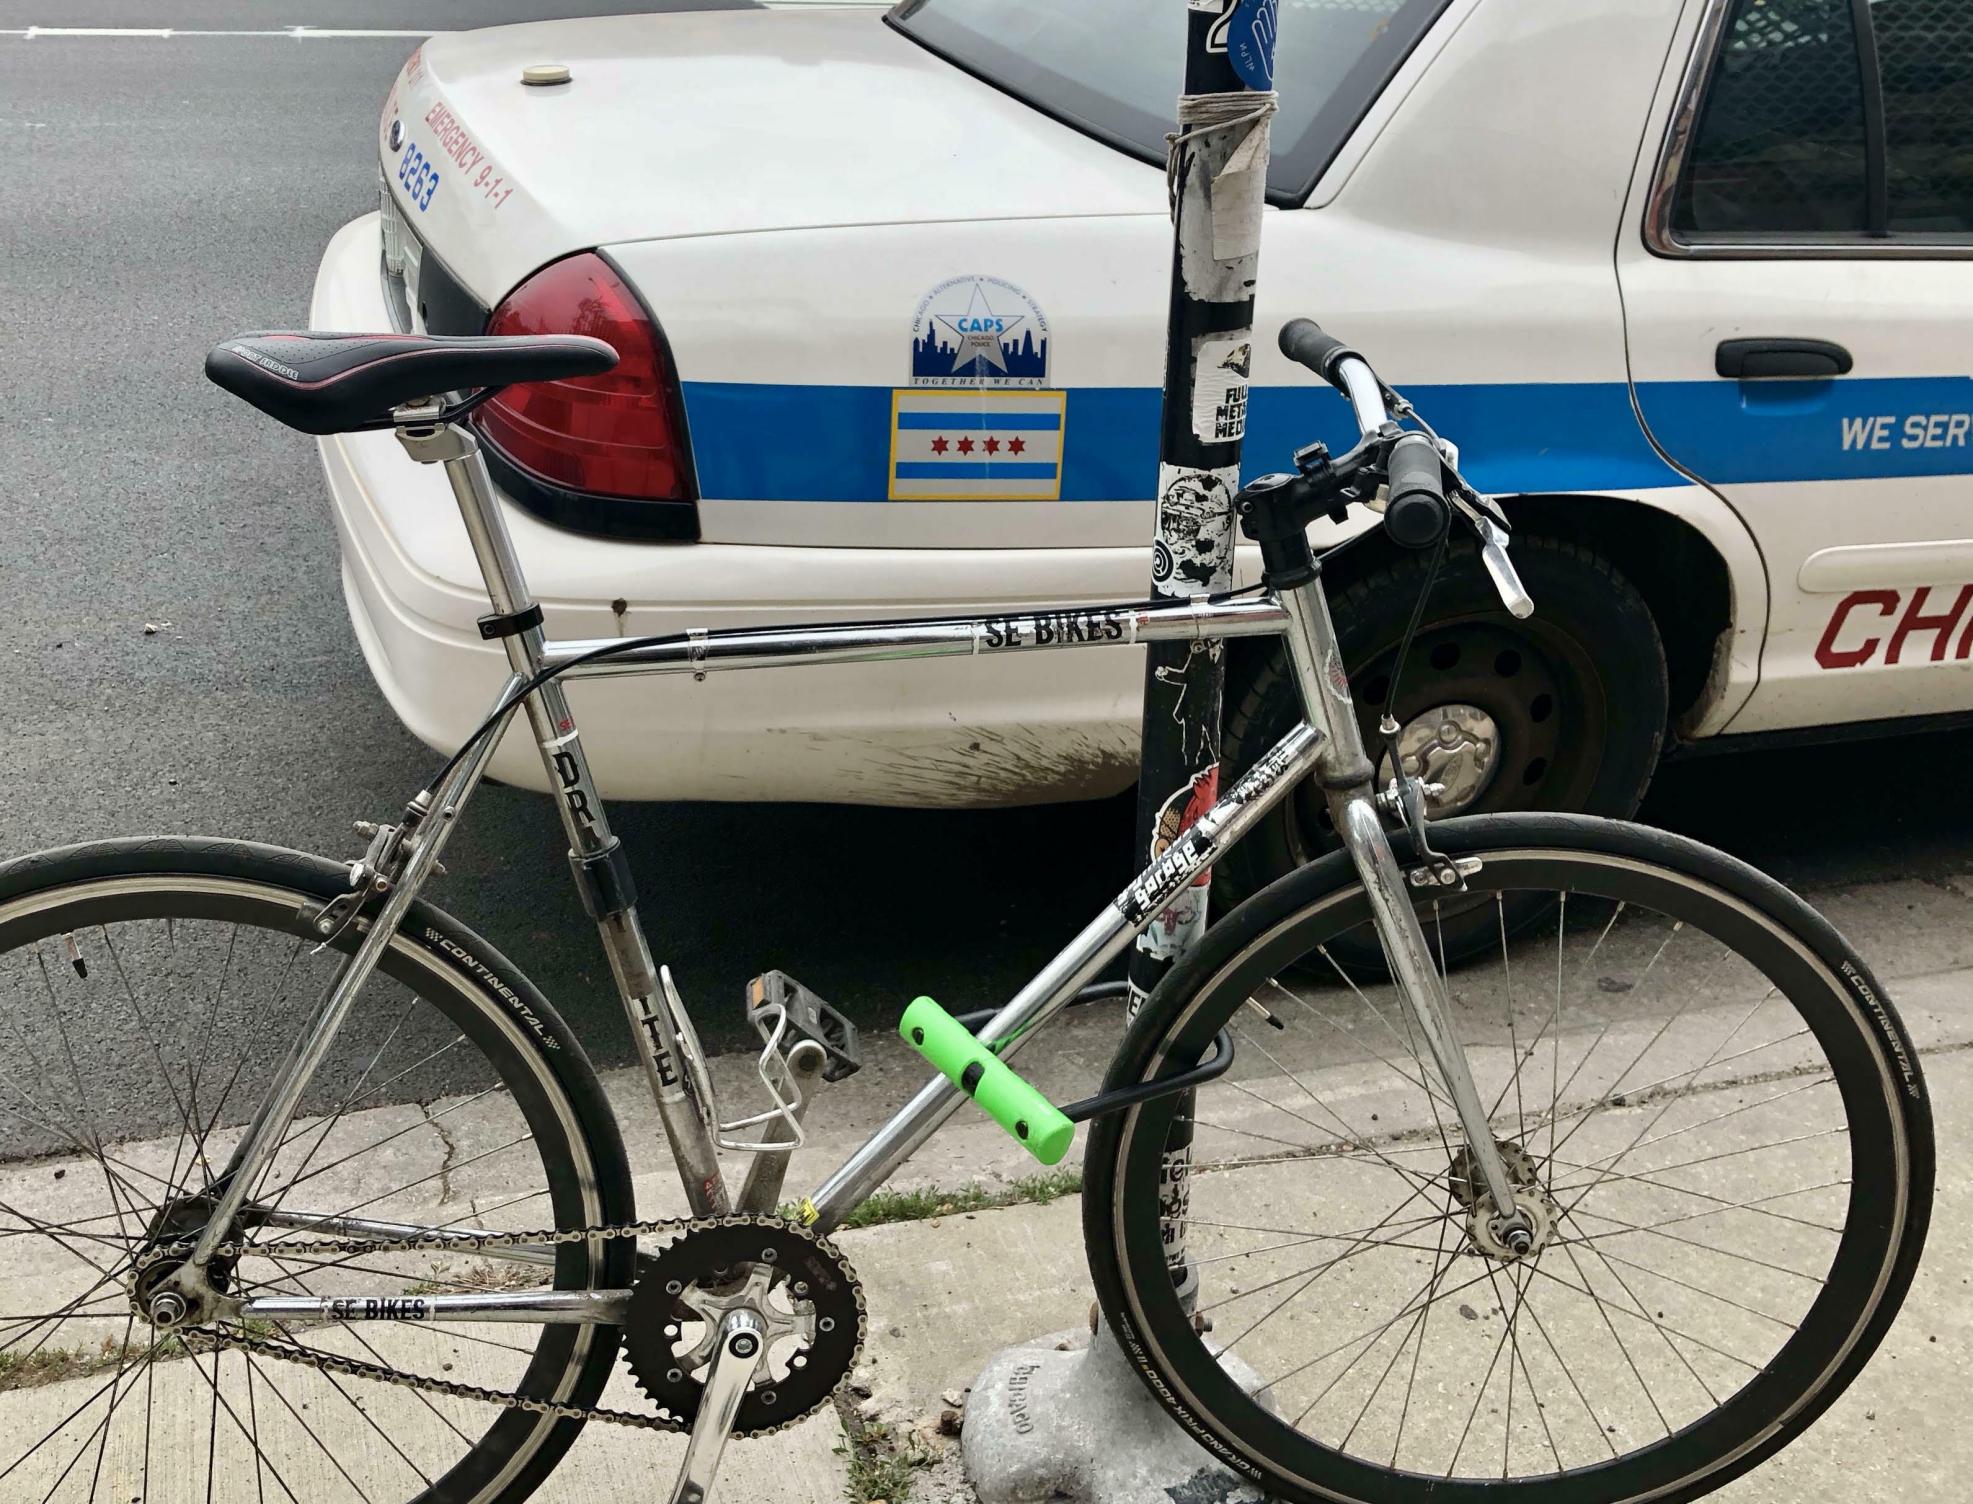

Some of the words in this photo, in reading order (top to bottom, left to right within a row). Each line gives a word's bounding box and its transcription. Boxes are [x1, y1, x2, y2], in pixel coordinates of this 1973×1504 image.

[425, 101, 484, 175] EMERGENCY
[473, 165, 514, 209] 9-1-1
[398, 142, 440, 212] 8263
[957, 318, 1004, 333] CAPS
[913, 377, 985, 386] TOGETHER
[993, 377, 1010, 386] WE
[1018, 377, 1044, 386] CAN
[1841, 416, 1895, 451] WE
[1901, 414, 1973, 449] SER
[985, 617, 1022, 648] SE
[1034, 612, 1123, 645] BIKES
[1134, 840, 1199, 910] garage
[440, 938, 544, 1036] CONTINENTAL
[1850, 974, 1914, 1082] CONTINENTAL
[332, 1299, 356, 1320] SE
[364, 1298, 425, 1320] BIKES
[1008, 1366, 1034, 1435] CHICAGO
[1146, 1368, 1177, 1405] 4000
[1174, 1405, 1205, 1435] PRIX
[1202, 1433, 1250, 1471] GRAND
